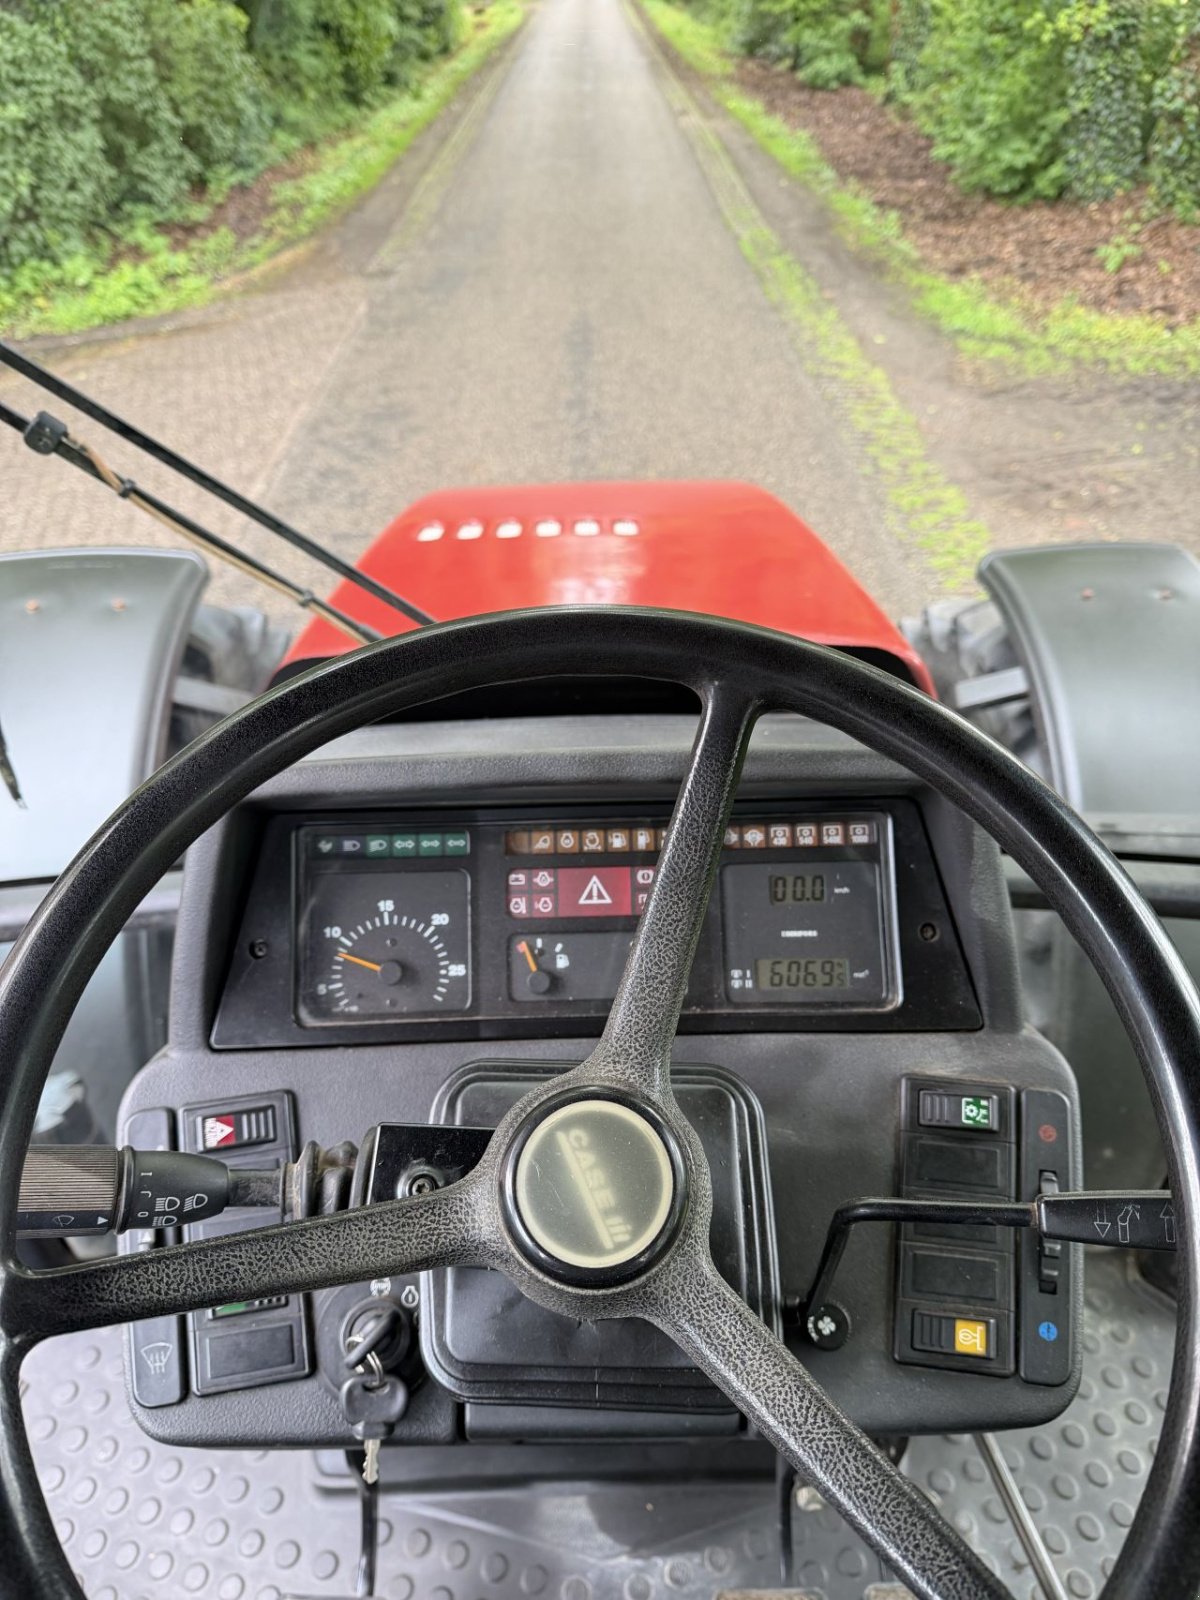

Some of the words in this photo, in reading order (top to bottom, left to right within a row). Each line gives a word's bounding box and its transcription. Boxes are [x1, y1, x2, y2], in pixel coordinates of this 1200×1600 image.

[377, 900, 395, 912] 15
[431, 913, 450, 926] 20
[323, 926, 342, 939] 10
[448, 964, 467, 977] 25
[317, 984, 327, 996] 5
[567, 1129, 616, 1208] CASE
